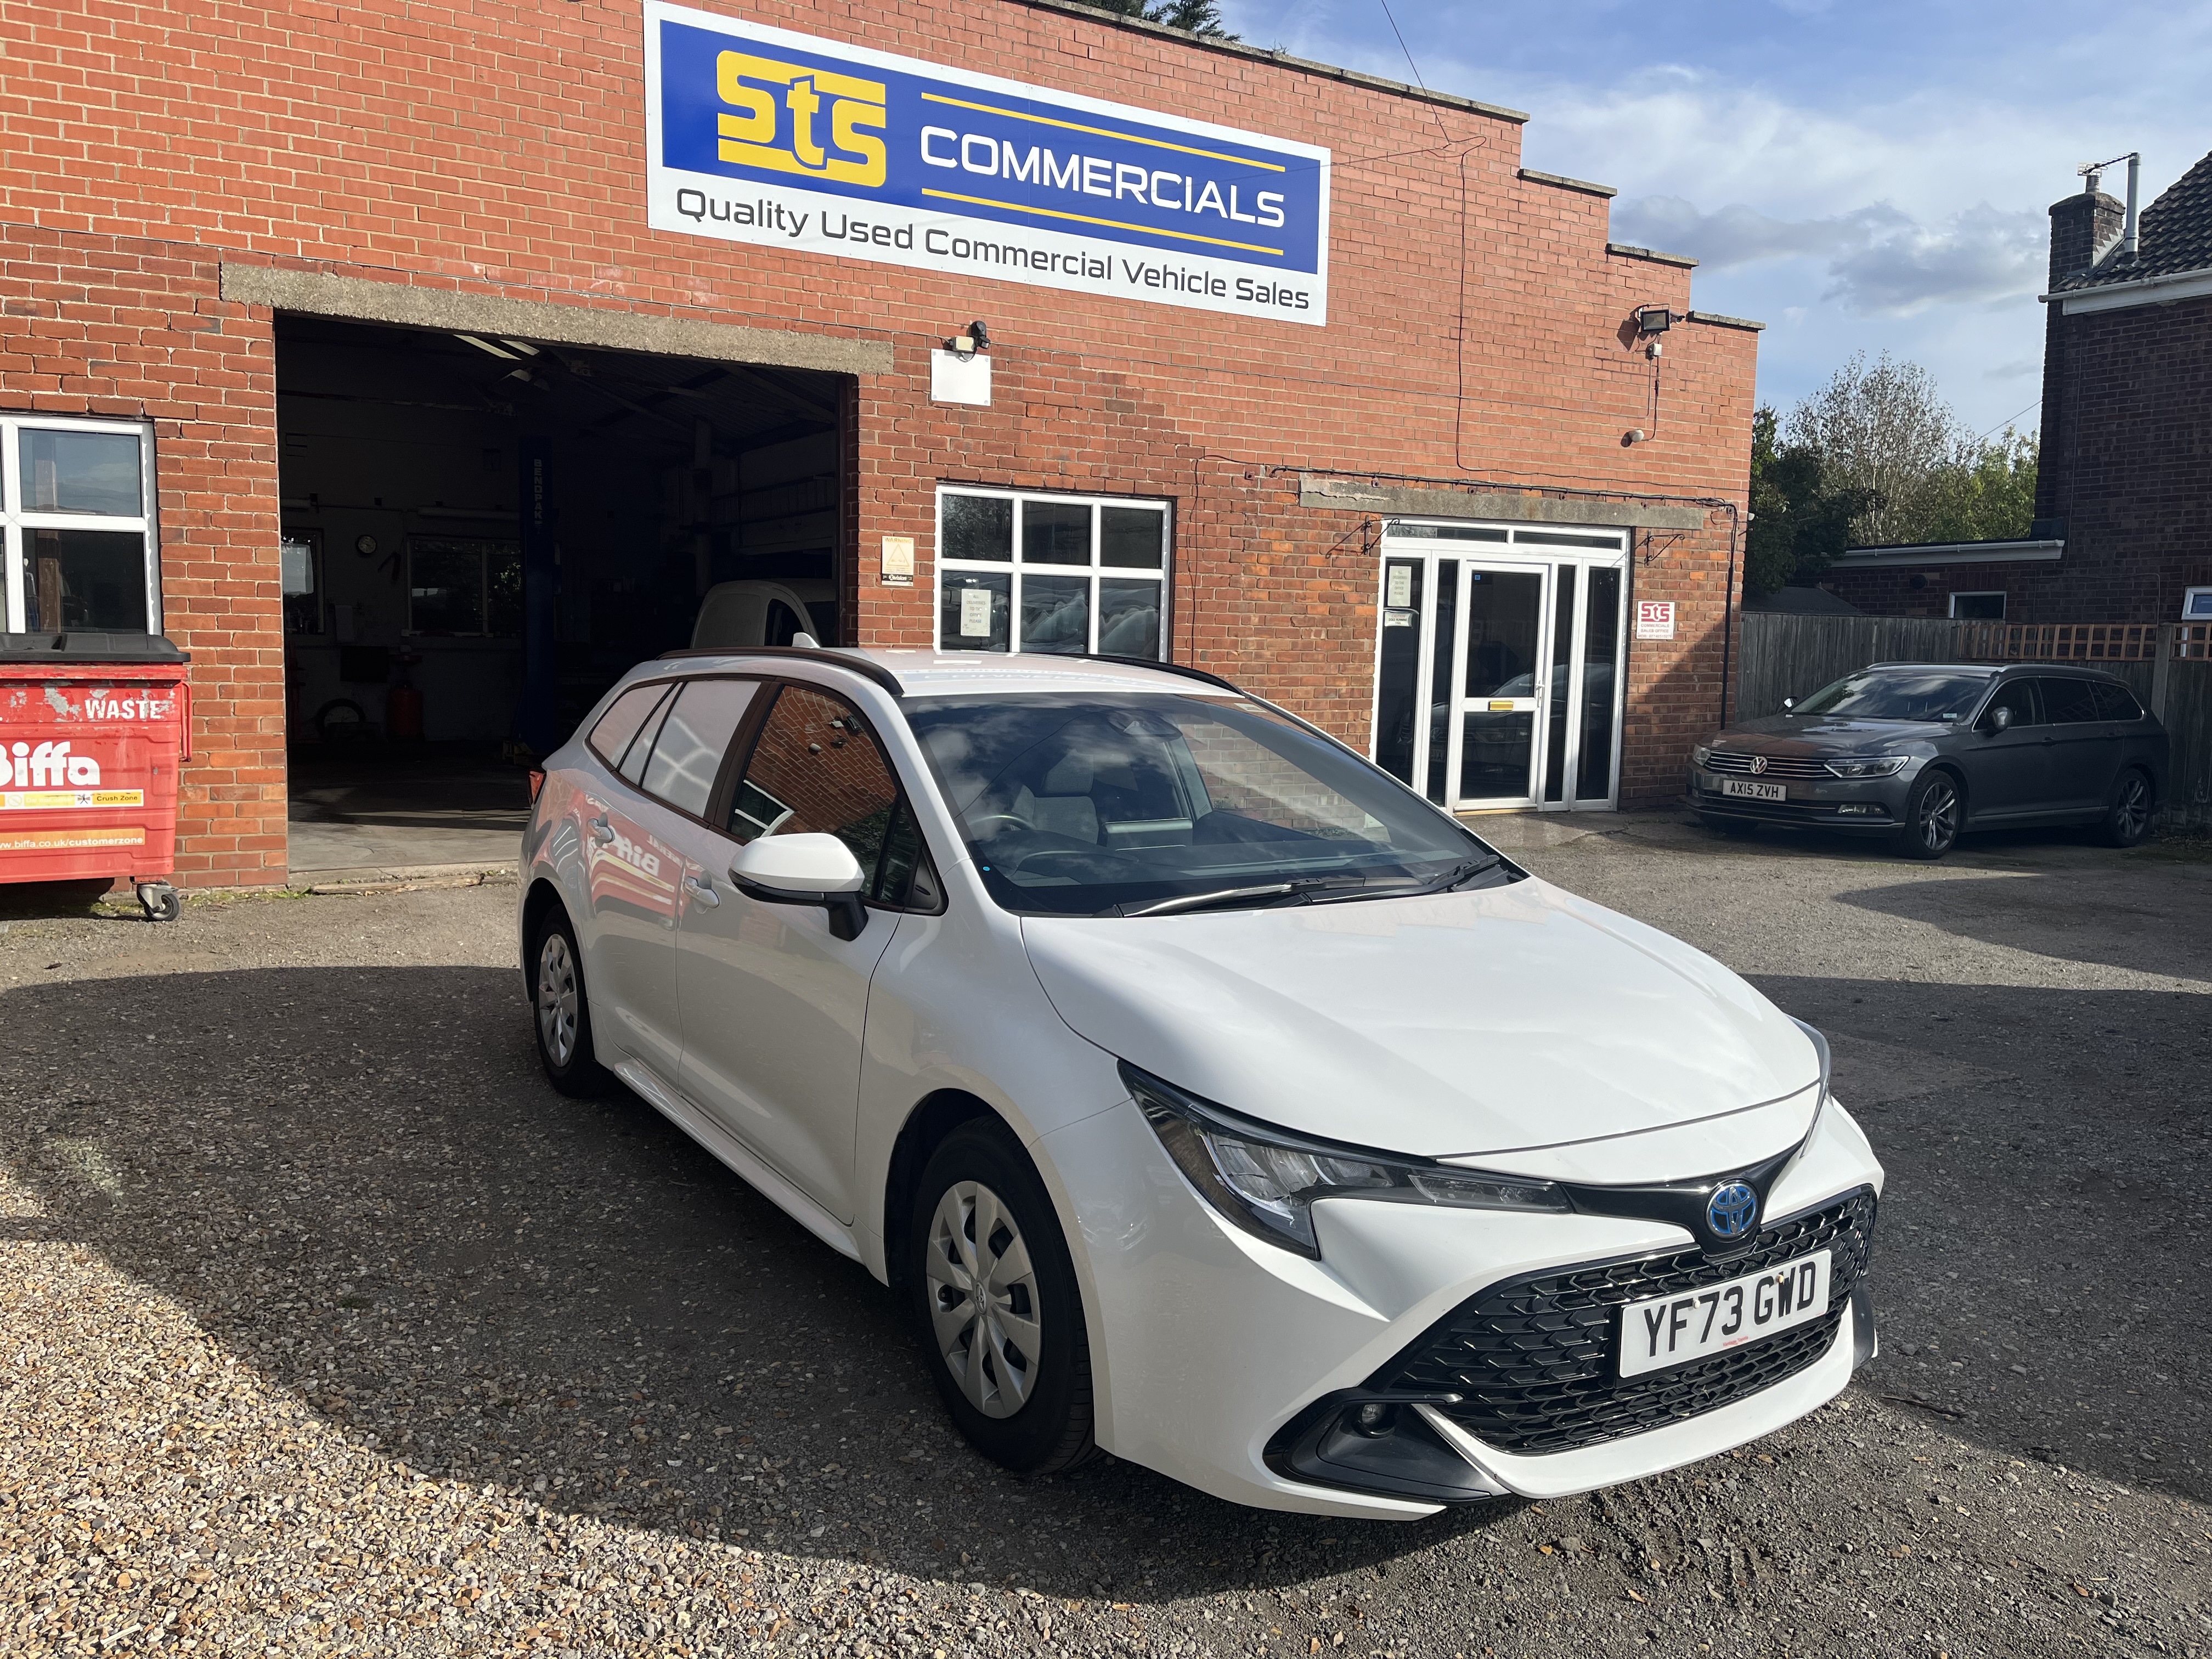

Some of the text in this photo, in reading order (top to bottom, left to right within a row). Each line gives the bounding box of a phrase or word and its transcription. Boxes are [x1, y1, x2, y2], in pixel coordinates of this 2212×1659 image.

[921, 126, 1284, 228] COMMERCIALS
[676, 188, 1310, 309] Quality Used Commercial Vehicle Sales
[534, 459, 543, 519] BENDPAK
[84, 698, 162, 720] WASTE
[1730, 782, 1779, 798] AX15 ZVH
[1644, 1261, 1816, 1357] YF73 GWD
